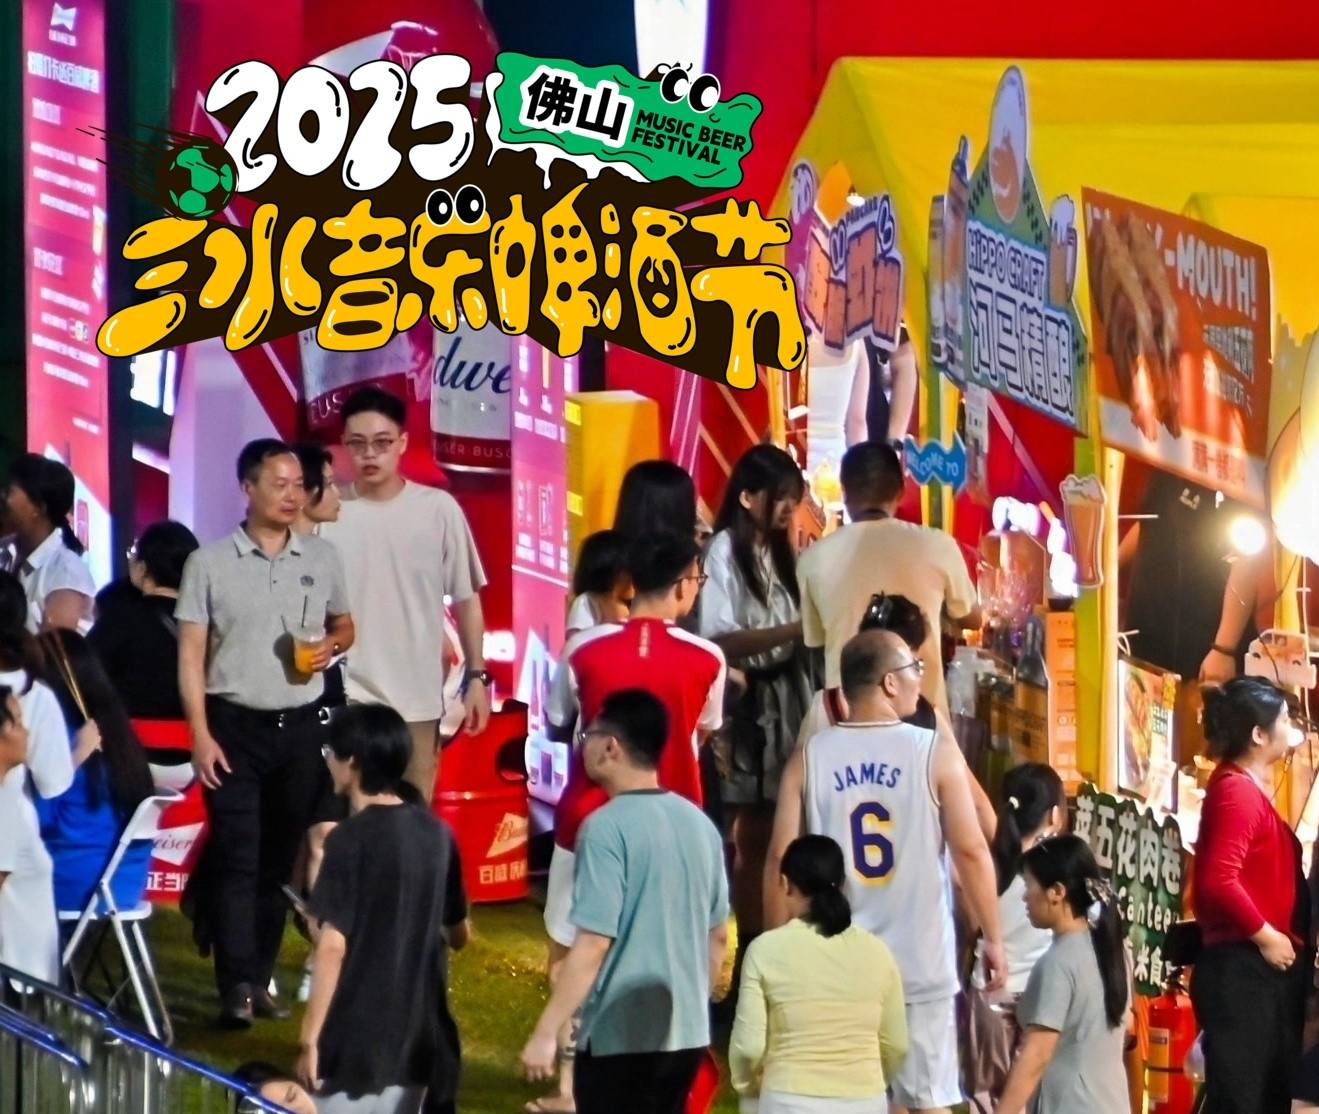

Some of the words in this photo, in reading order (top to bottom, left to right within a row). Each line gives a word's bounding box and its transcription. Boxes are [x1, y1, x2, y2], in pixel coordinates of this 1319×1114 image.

[1007, 243, 1046, 301] CRAFT
[970, 280, 1074, 416] 河马精酿
[834, 763, 901, 792] JAMES
[850, 802, 895, 880] 6
